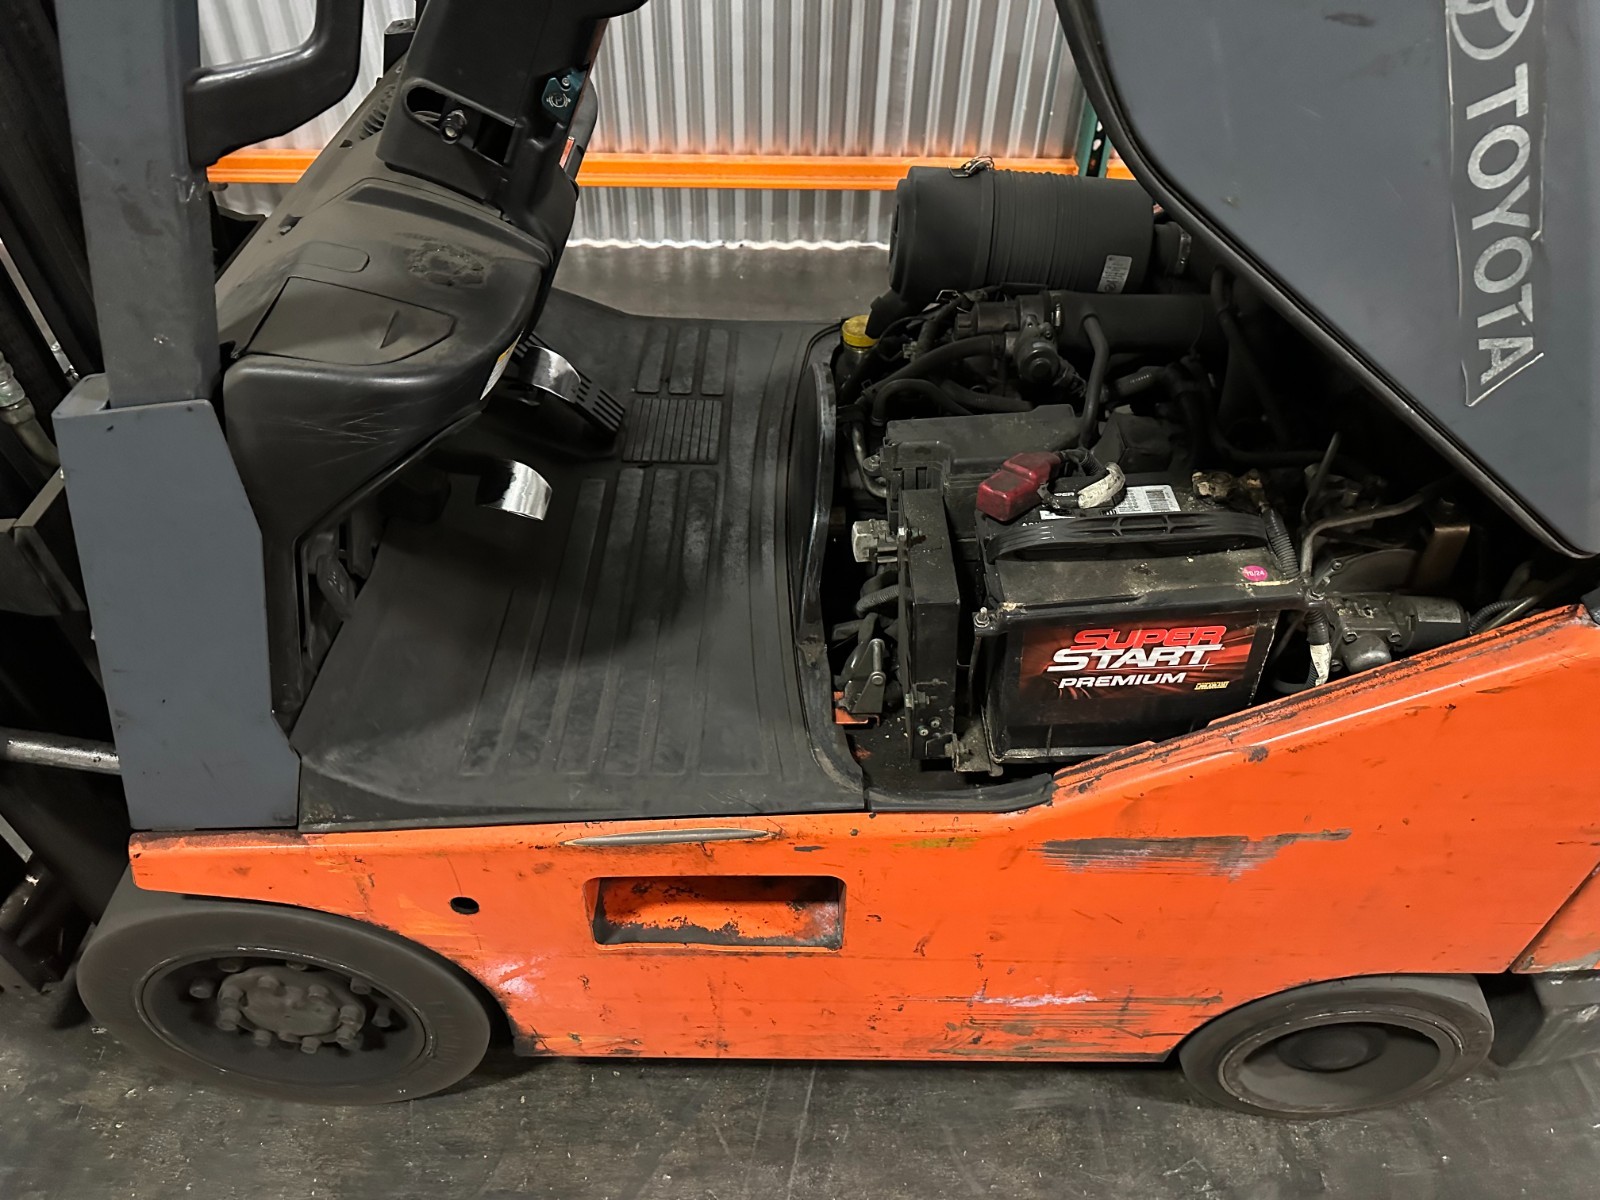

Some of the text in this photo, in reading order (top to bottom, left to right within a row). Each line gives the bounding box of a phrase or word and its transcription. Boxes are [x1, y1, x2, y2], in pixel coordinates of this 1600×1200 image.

[1466, 62, 1534, 385] TOYOTA
[1071, 625, 1227, 650] SUPER
[1047, 644, 1224, 672] START
[1058, 672, 1187, 689] PREMIUM
